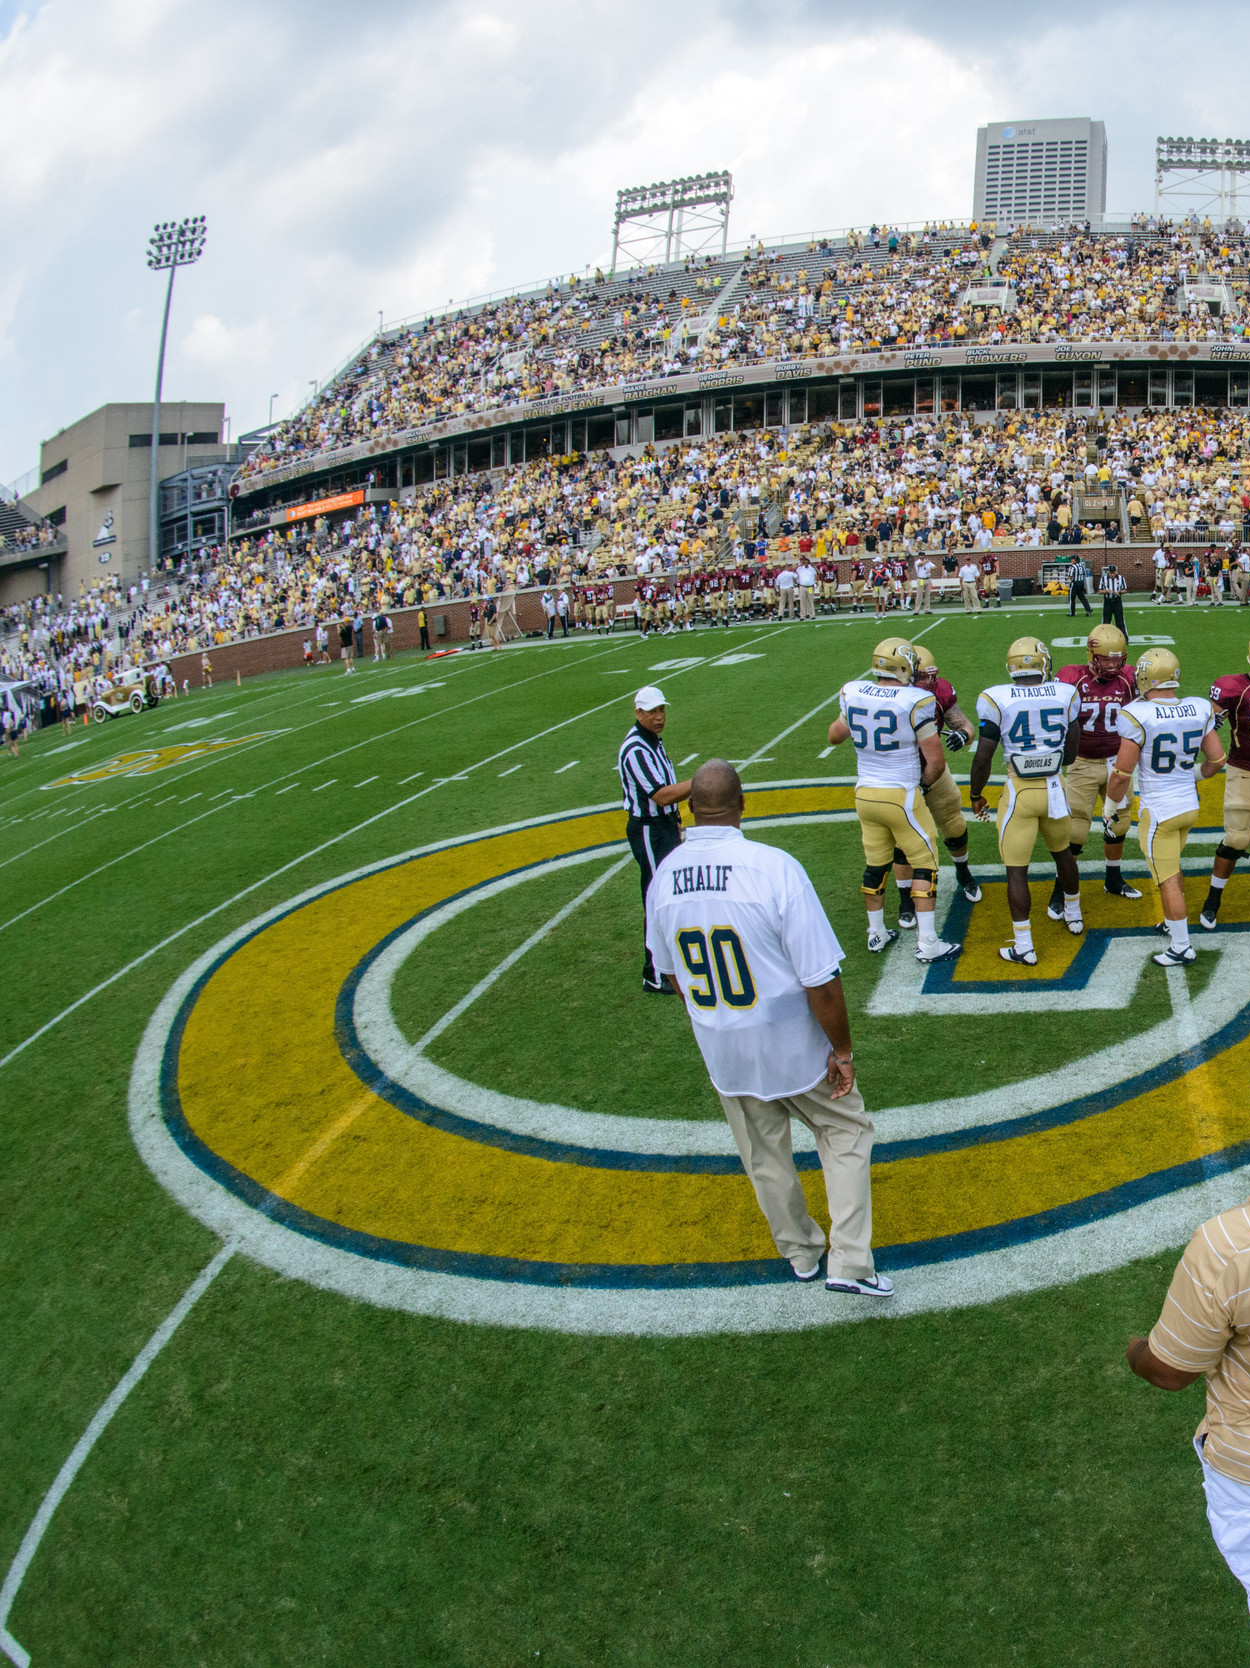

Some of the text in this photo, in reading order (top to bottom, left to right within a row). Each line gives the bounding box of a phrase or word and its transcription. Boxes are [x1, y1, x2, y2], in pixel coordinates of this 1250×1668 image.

[1018, 128, 1036, 136] at&t
[905, 357, 942, 368] PUND
[966, 353, 1027, 364] FLOWERS
[1056, 351, 1102, 362] GUYON
[775, 363, 802, 372] BOBBY
[776, 368, 811, 380] DAVIS
[699, 372, 727, 382] GEORGE
[700, 376, 744, 390] MORRIS
[531, 391, 592, 407] COLLEGE FOOTBALL
[624, 385, 677, 400] BAUGHAN
[523, 396, 605, 420] HALL OF FAME
[859, 685, 900, 698] JACKSON
[1011, 685, 1056, 698] ATTAOCHU
[1082, 683, 1088, 693] C
[1209, 685, 1221, 700] 59
[1081, 702, 1122, 732] 70
[1156, 704, 1197, 719] ALFORD
[848, 706, 899, 752] 52
[1008, 707, 1066, 752] 45
[1151, 730, 1203, 774] 65
[1024, 758, 1052, 768] DOUGLAS
[673, 865, 733, 895] KHALIF
[869, 935, 881, 948] NIKE
[675, 924, 758, 1010] 90
